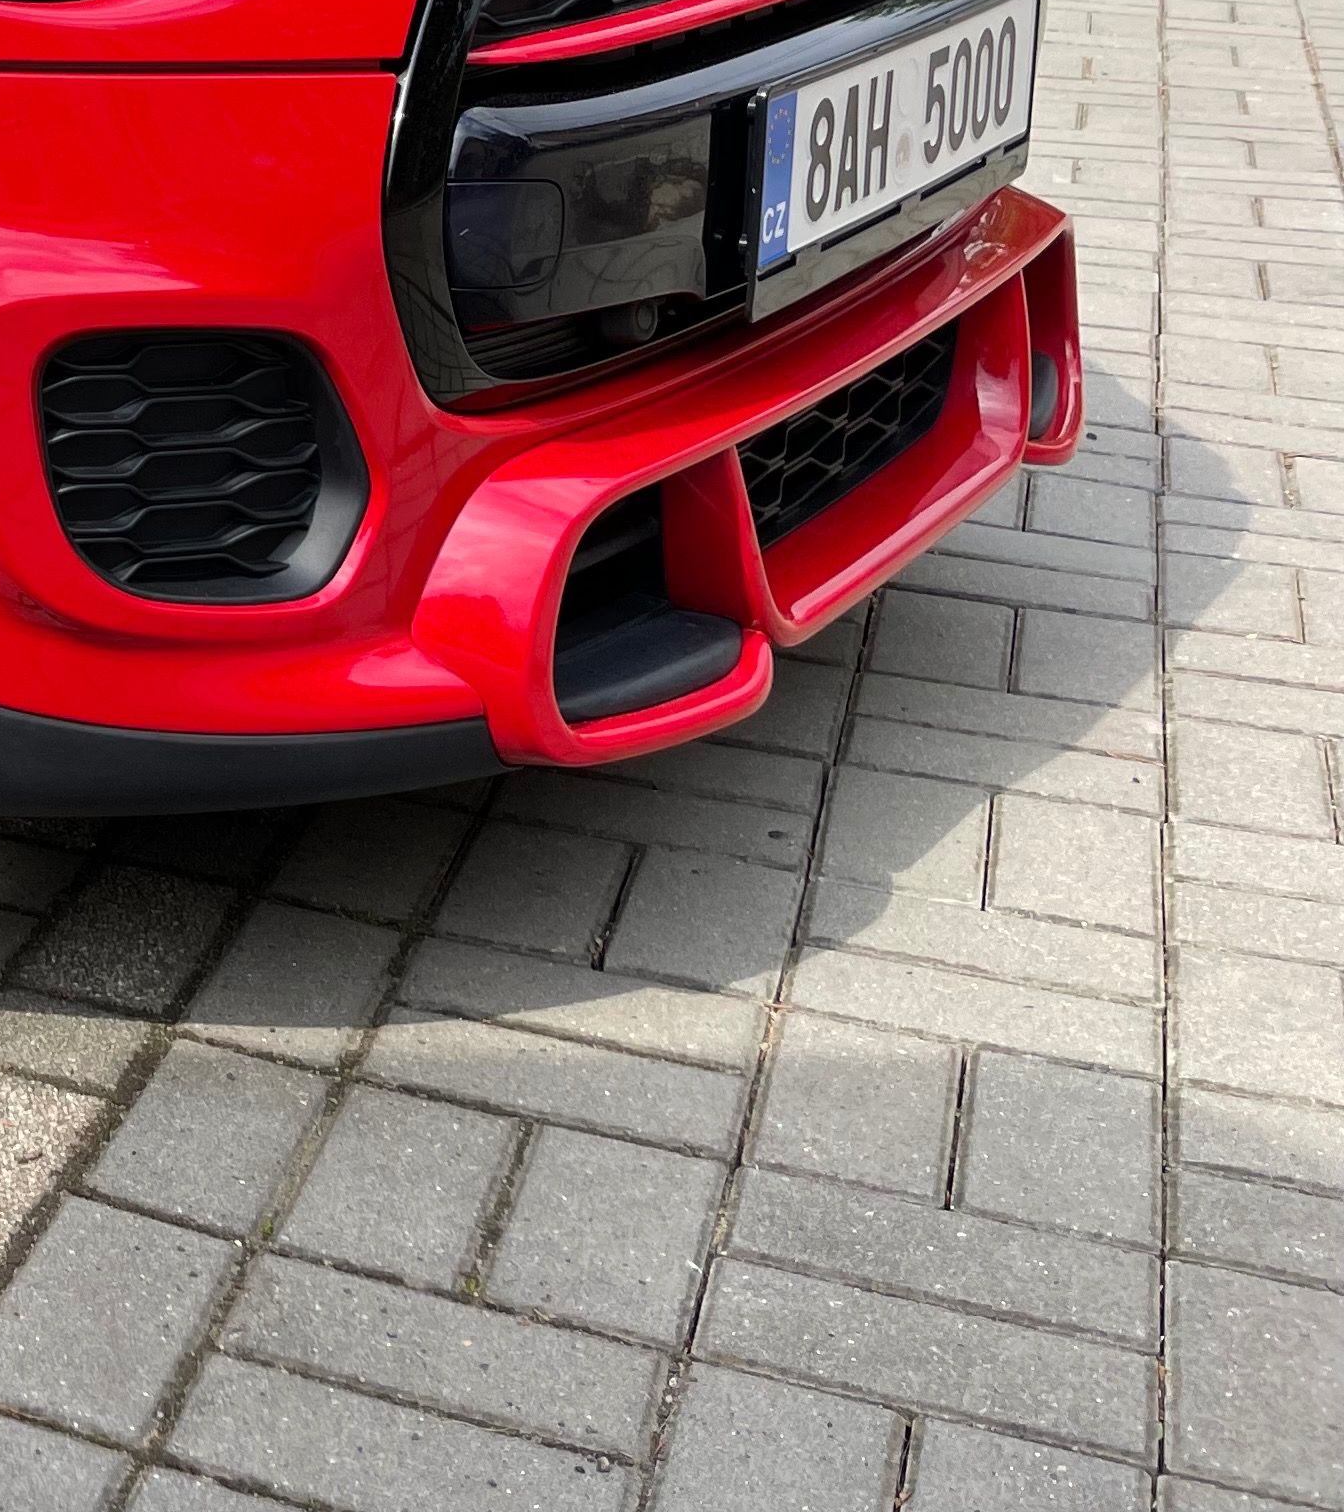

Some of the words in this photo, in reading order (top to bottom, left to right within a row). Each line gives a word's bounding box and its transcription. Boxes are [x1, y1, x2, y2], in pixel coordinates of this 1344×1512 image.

[805, 69, 895, 223] 8AH
[923, 15, 1017, 165] 5000
[761, 200, 787, 244] CZ
